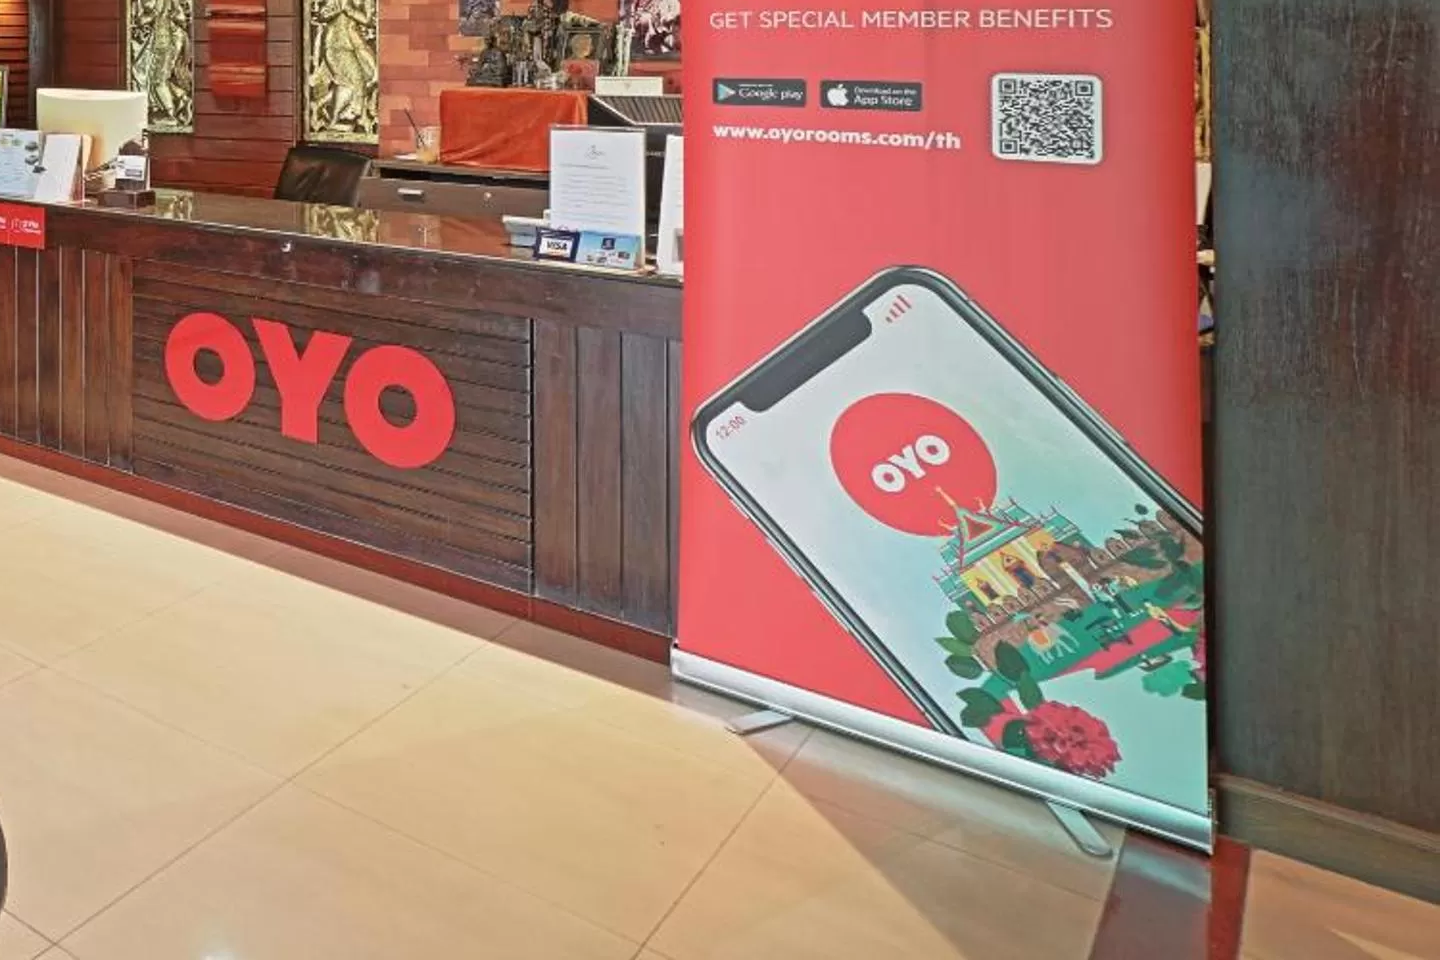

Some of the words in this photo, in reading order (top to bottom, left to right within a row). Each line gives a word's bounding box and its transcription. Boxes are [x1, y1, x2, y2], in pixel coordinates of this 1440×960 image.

[709, 11, 753, 29] GET
[759, 10, 854, 29] SPECIAL
[861, 9, 970, 28] MEMBER
[978, 8, 1113, 29] BENEFITS
[853, 94, 878, 106] App
[881, 95, 913, 107] Store
[713, 124, 961, 150] www.oyorooms.com/th
[164, 311, 457, 470] OYO
[871, 434, 951, 493] OYO
